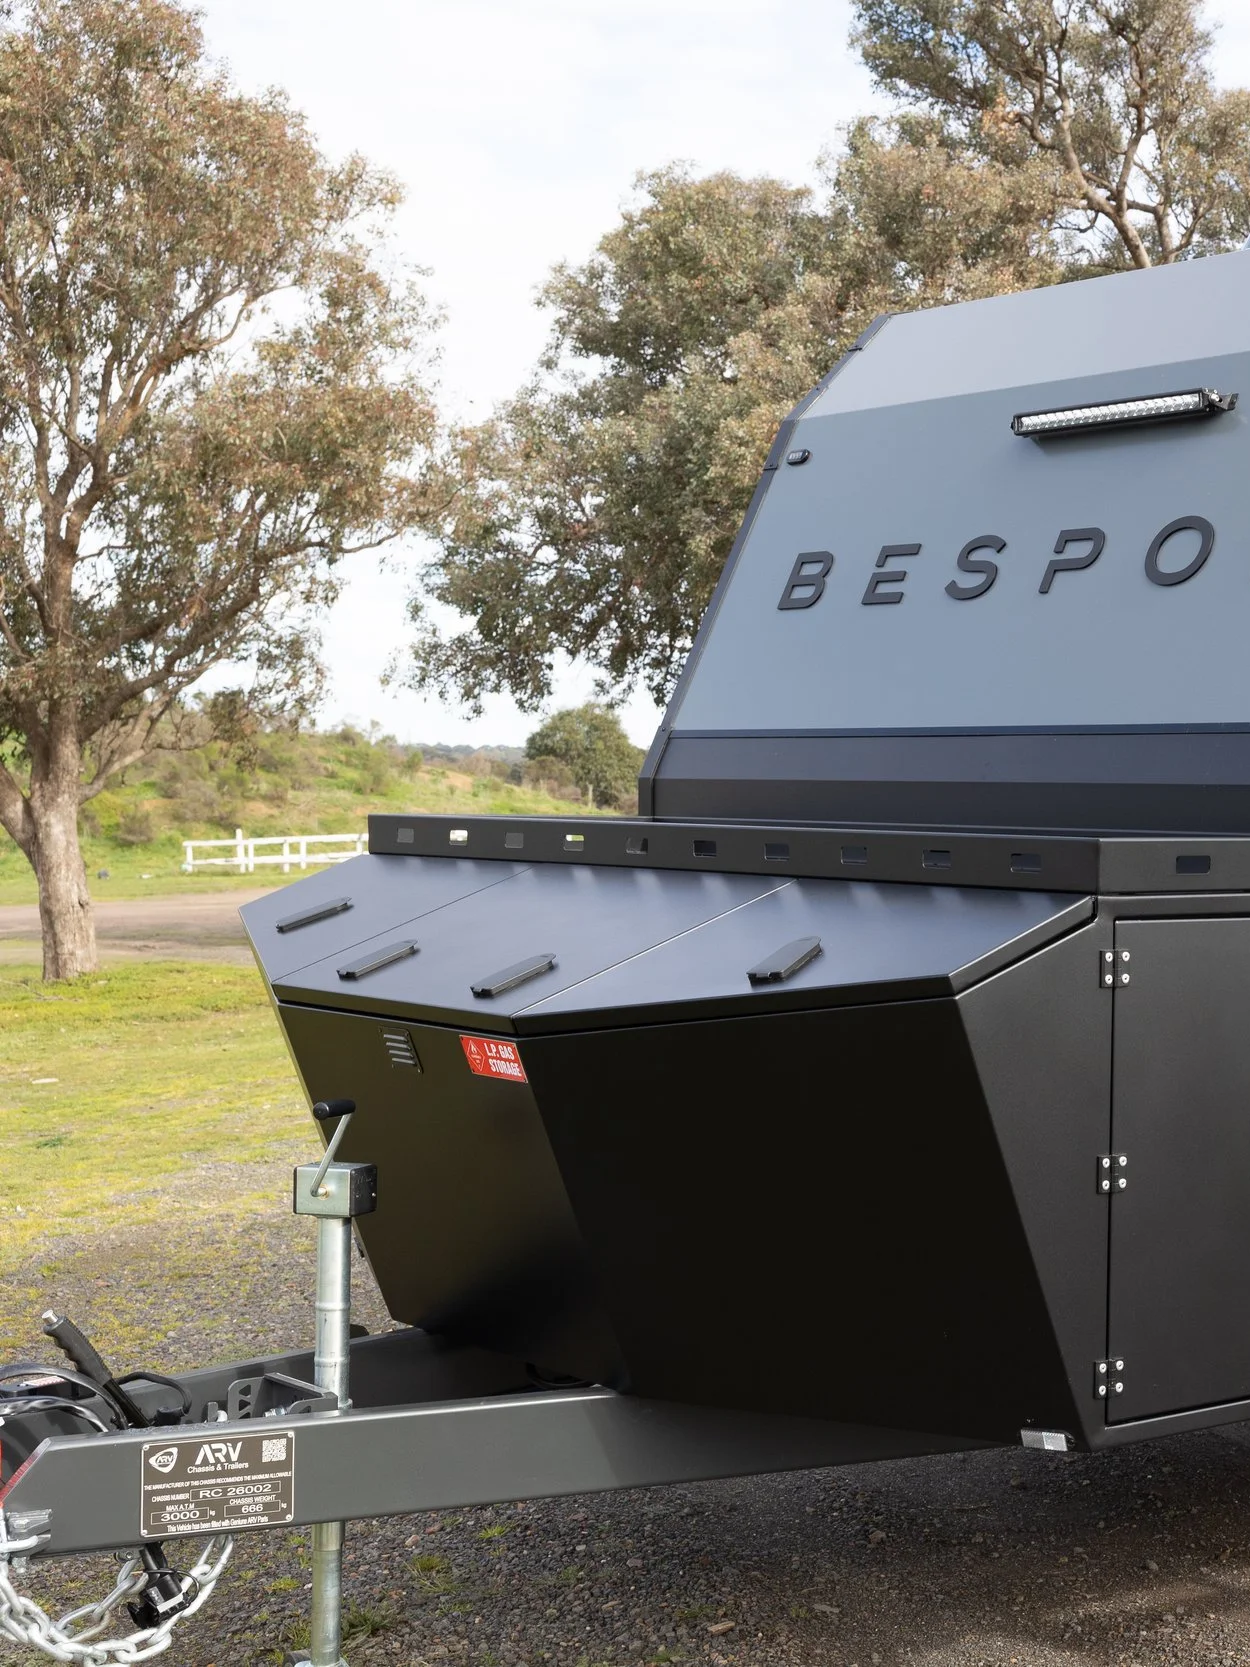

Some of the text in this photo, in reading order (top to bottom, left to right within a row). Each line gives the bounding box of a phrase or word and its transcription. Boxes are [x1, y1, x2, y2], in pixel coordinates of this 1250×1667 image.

[498, 1044, 515, 1060] GAS
[488, 1058, 522, 1077] STORAGE
[194, 1441, 243, 1466] ARV
[187, 1461, 249, 1474] Chassis & Trailers
[152, 1481, 185, 1490] MANUFACTURER
[199, 1483, 272, 1499] RC 26002
[151, 1492, 190, 1502] CHASSIS NUMBER
[229, 1494, 276, 1506] CHASSIS WEIGHT
[165, 1504, 179, 1512] MAX
[241, 1504, 263, 1514] 666
[160, 1509, 216, 1522] 3000 kg
[167, 1525, 177, 1533] This
[176, 1523, 192, 1532] Vehicle
[247, 1516, 258, 1525] ARV
[257, 1515, 269, 1523] Parts
